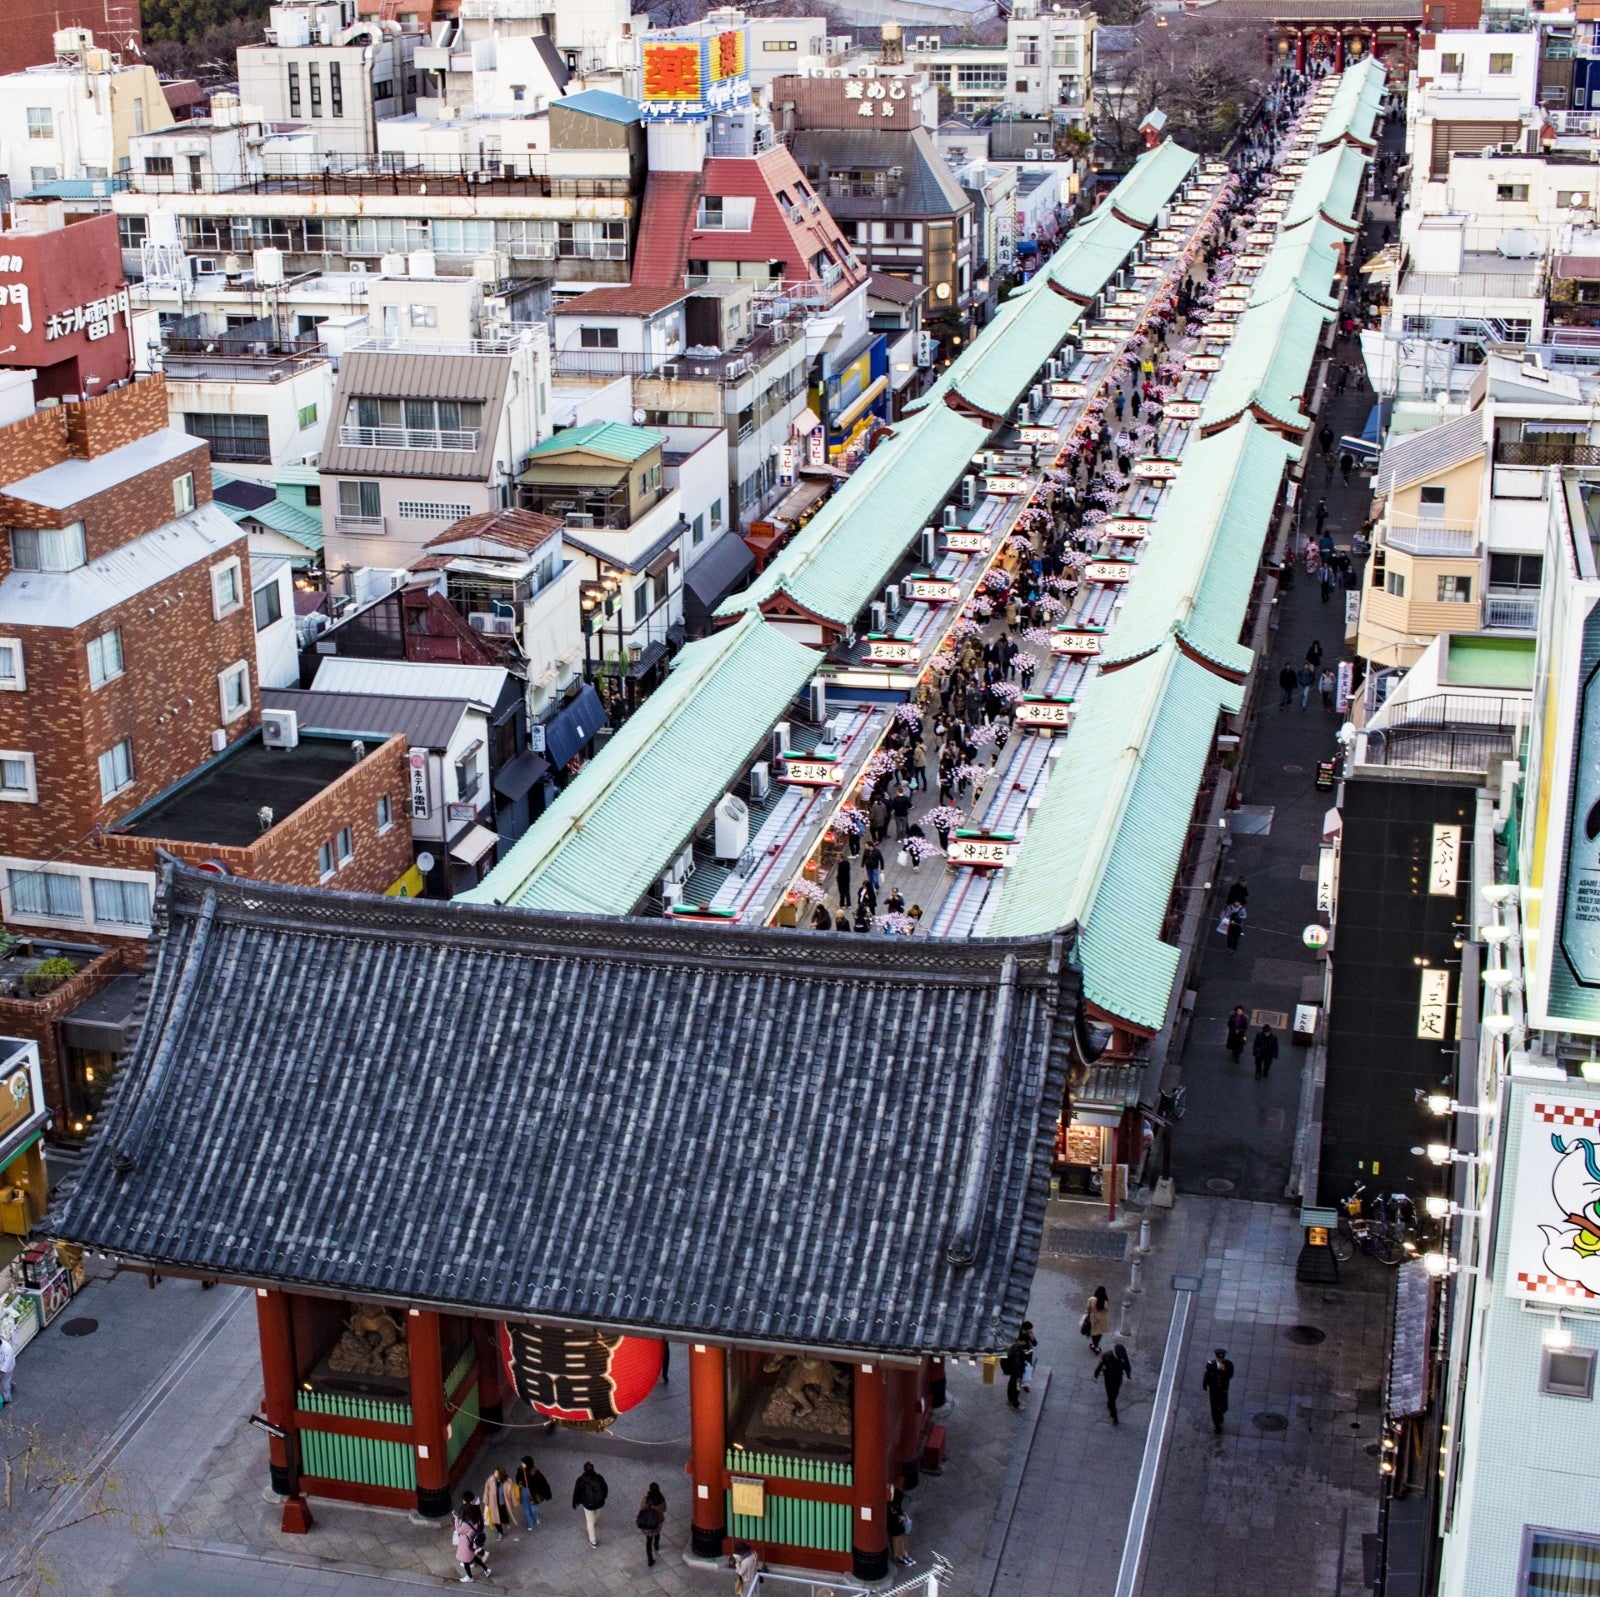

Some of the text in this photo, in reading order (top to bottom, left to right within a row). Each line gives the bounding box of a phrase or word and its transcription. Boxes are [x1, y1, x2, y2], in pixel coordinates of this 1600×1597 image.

[645, 46, 698, 96] 薬
[45, 291, 132, 341] ホテル雷門
[413, 769, 426, 816] ホテル雷門
